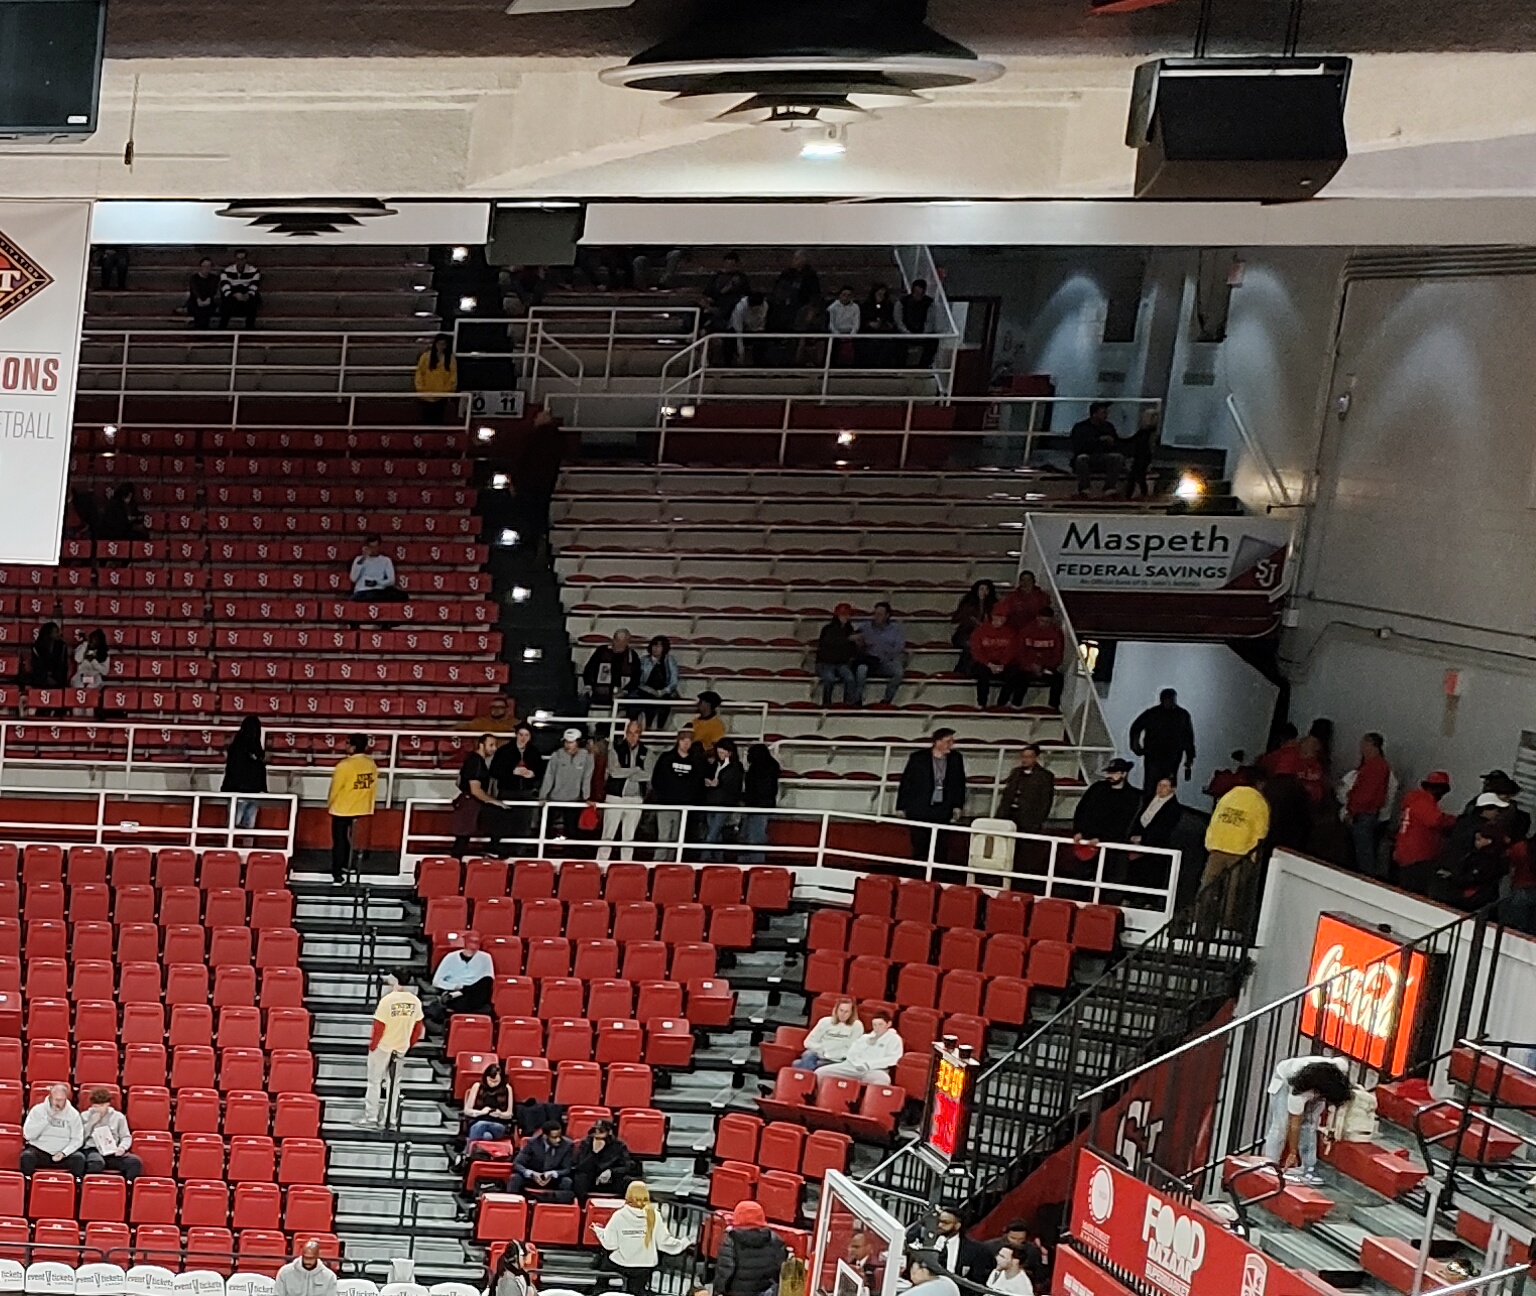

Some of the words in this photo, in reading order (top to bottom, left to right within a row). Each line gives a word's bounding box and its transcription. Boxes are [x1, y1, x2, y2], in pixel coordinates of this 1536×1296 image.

[1062, 522, 1229, 562] Maspeth
[1056, 563, 1140, 577] FEDERAL
[1145, 565, 1228, 580] SAVINGS
[1141, 1193, 1206, 1272] FOOD
[1146, 1237, 1196, 1284] BAZAAR
